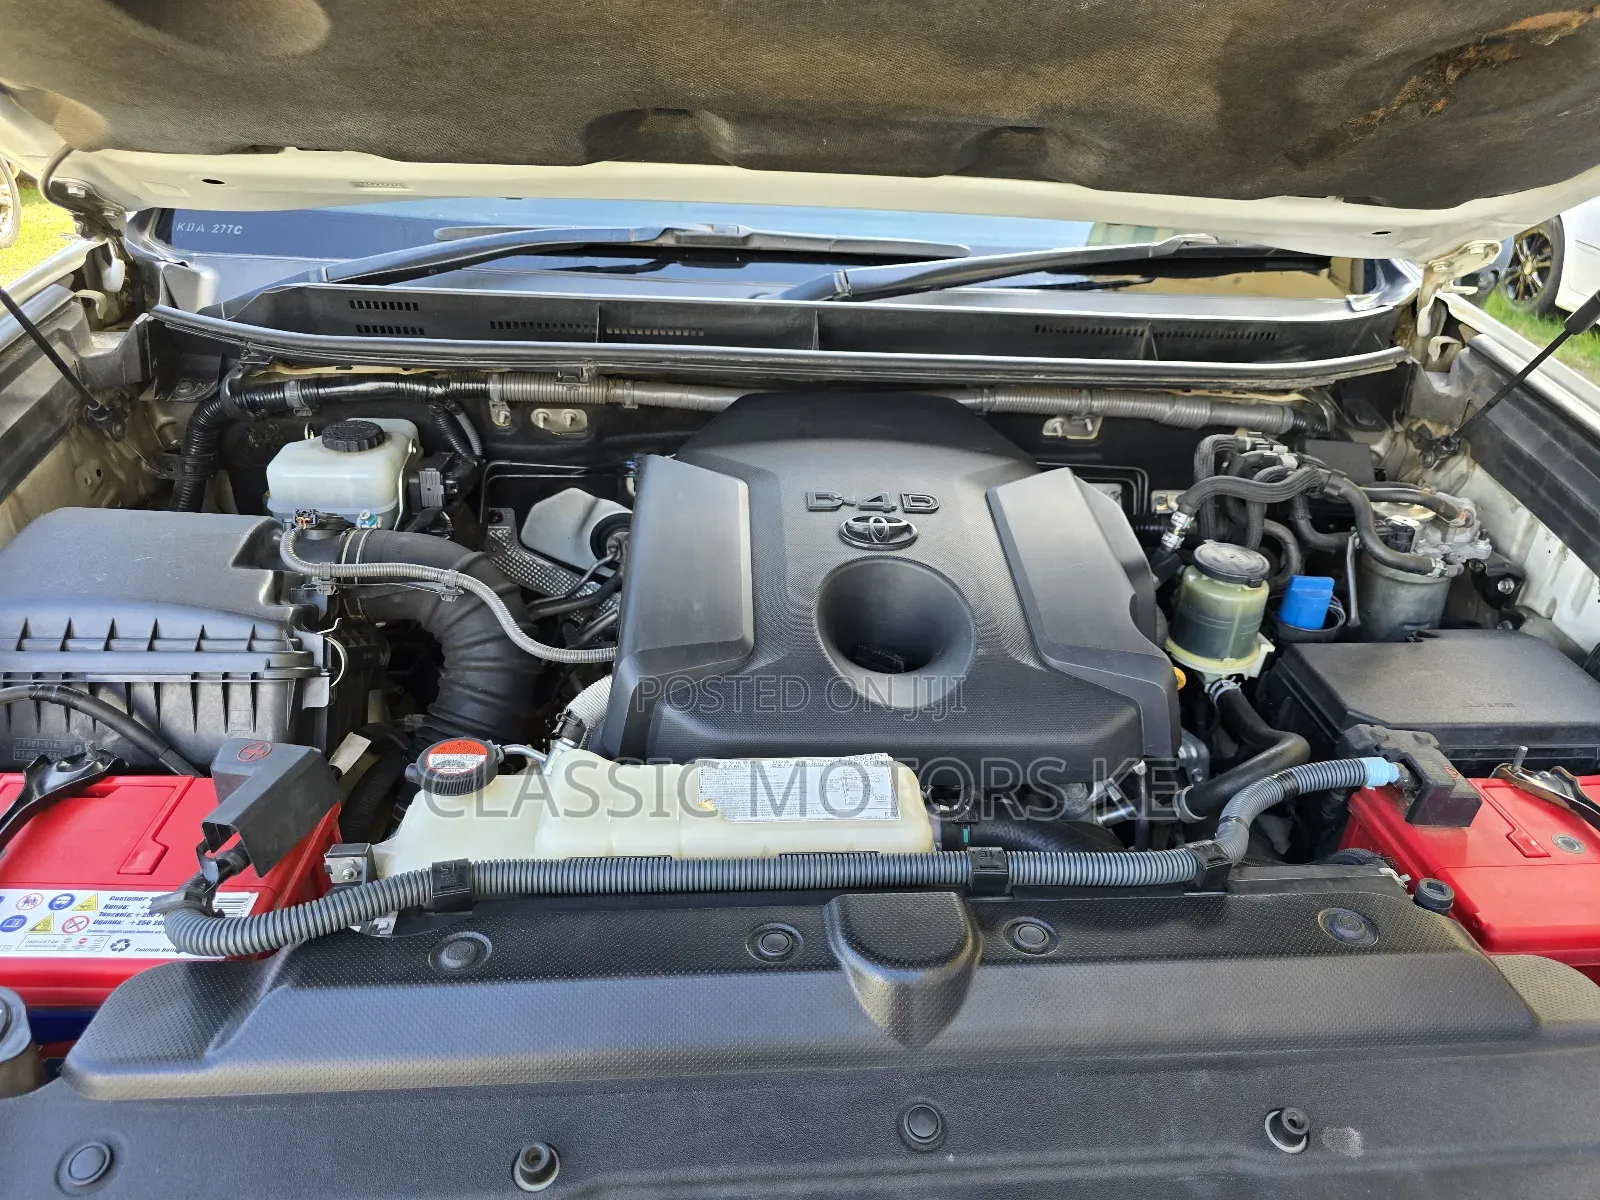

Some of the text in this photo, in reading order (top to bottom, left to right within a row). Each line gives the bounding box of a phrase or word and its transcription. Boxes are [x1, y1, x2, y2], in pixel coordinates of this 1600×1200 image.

[211, 224, 243, 235] 277C
[806, 491, 940, 514] D-4D
[103, 903, 131, 911] Kenya:
